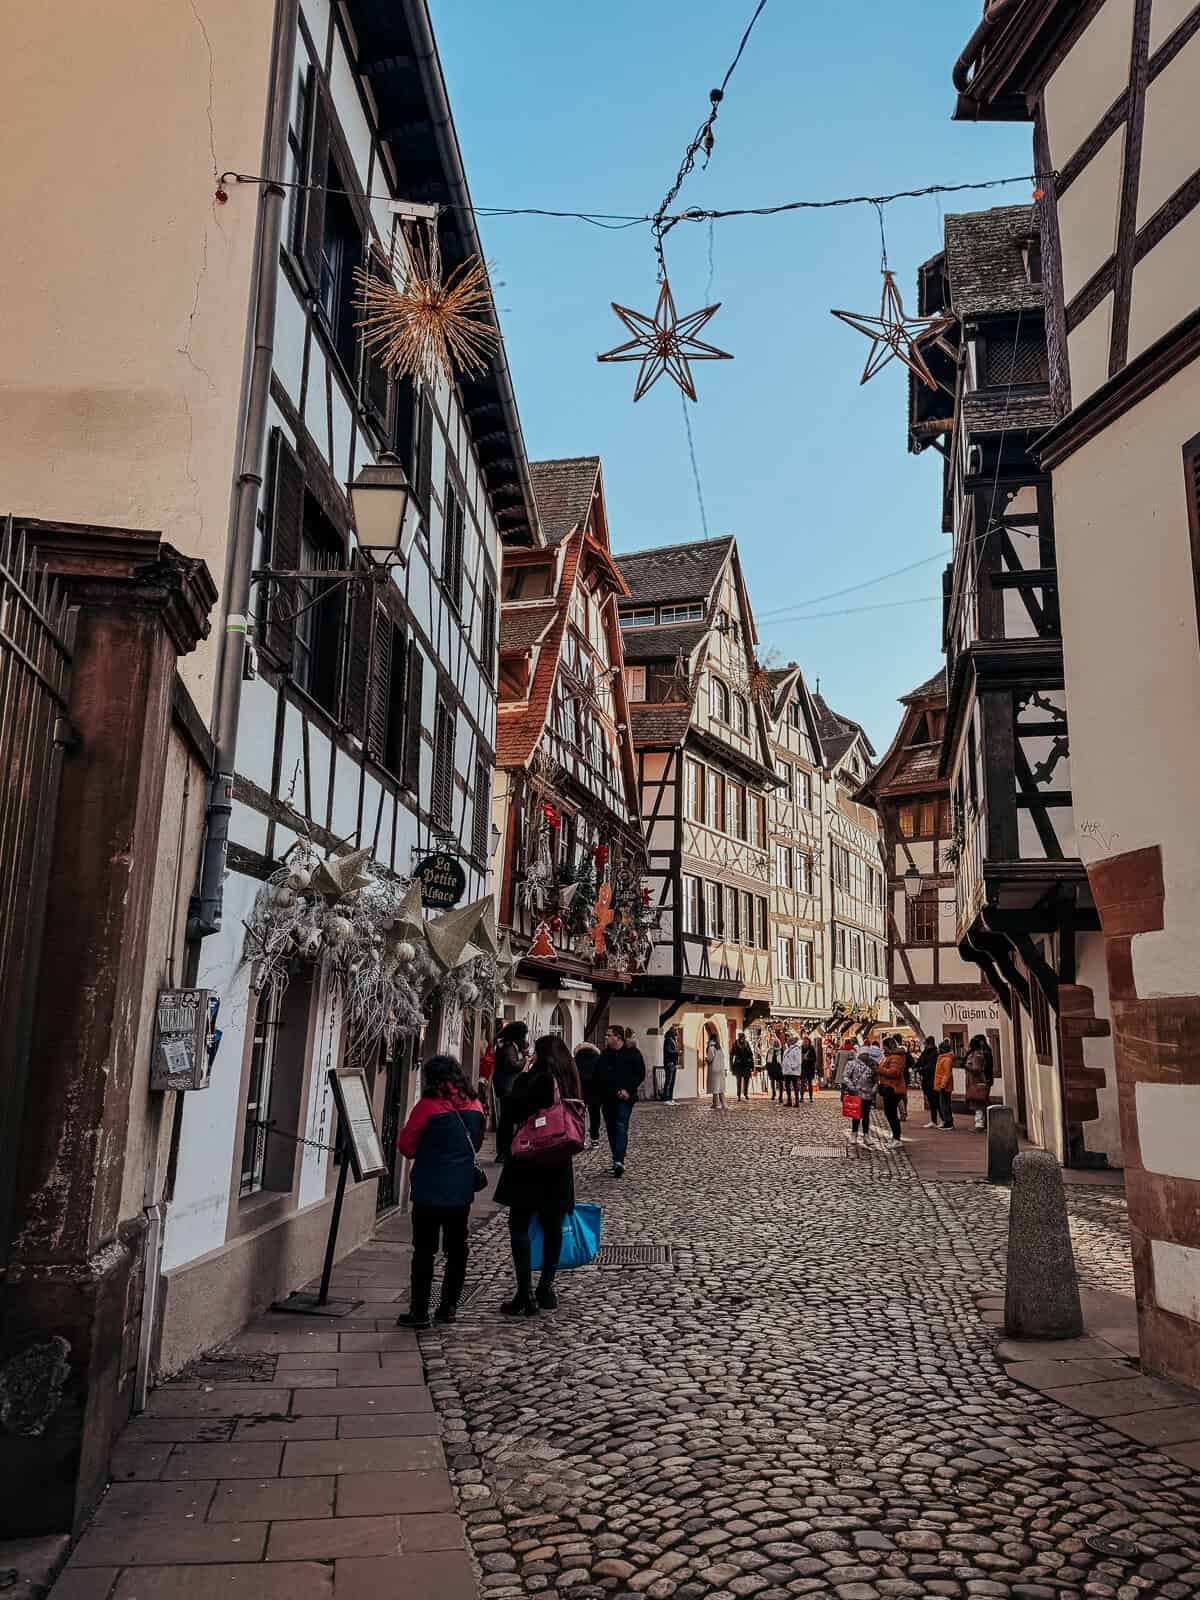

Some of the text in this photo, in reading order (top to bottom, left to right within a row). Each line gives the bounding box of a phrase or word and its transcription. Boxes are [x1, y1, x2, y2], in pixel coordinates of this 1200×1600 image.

[435, 857, 450, 872] La
[424, 868, 457, 887] Petite
[420, 886, 455, 902] Alsace
[944, 1003, 987, 1022] Maison
